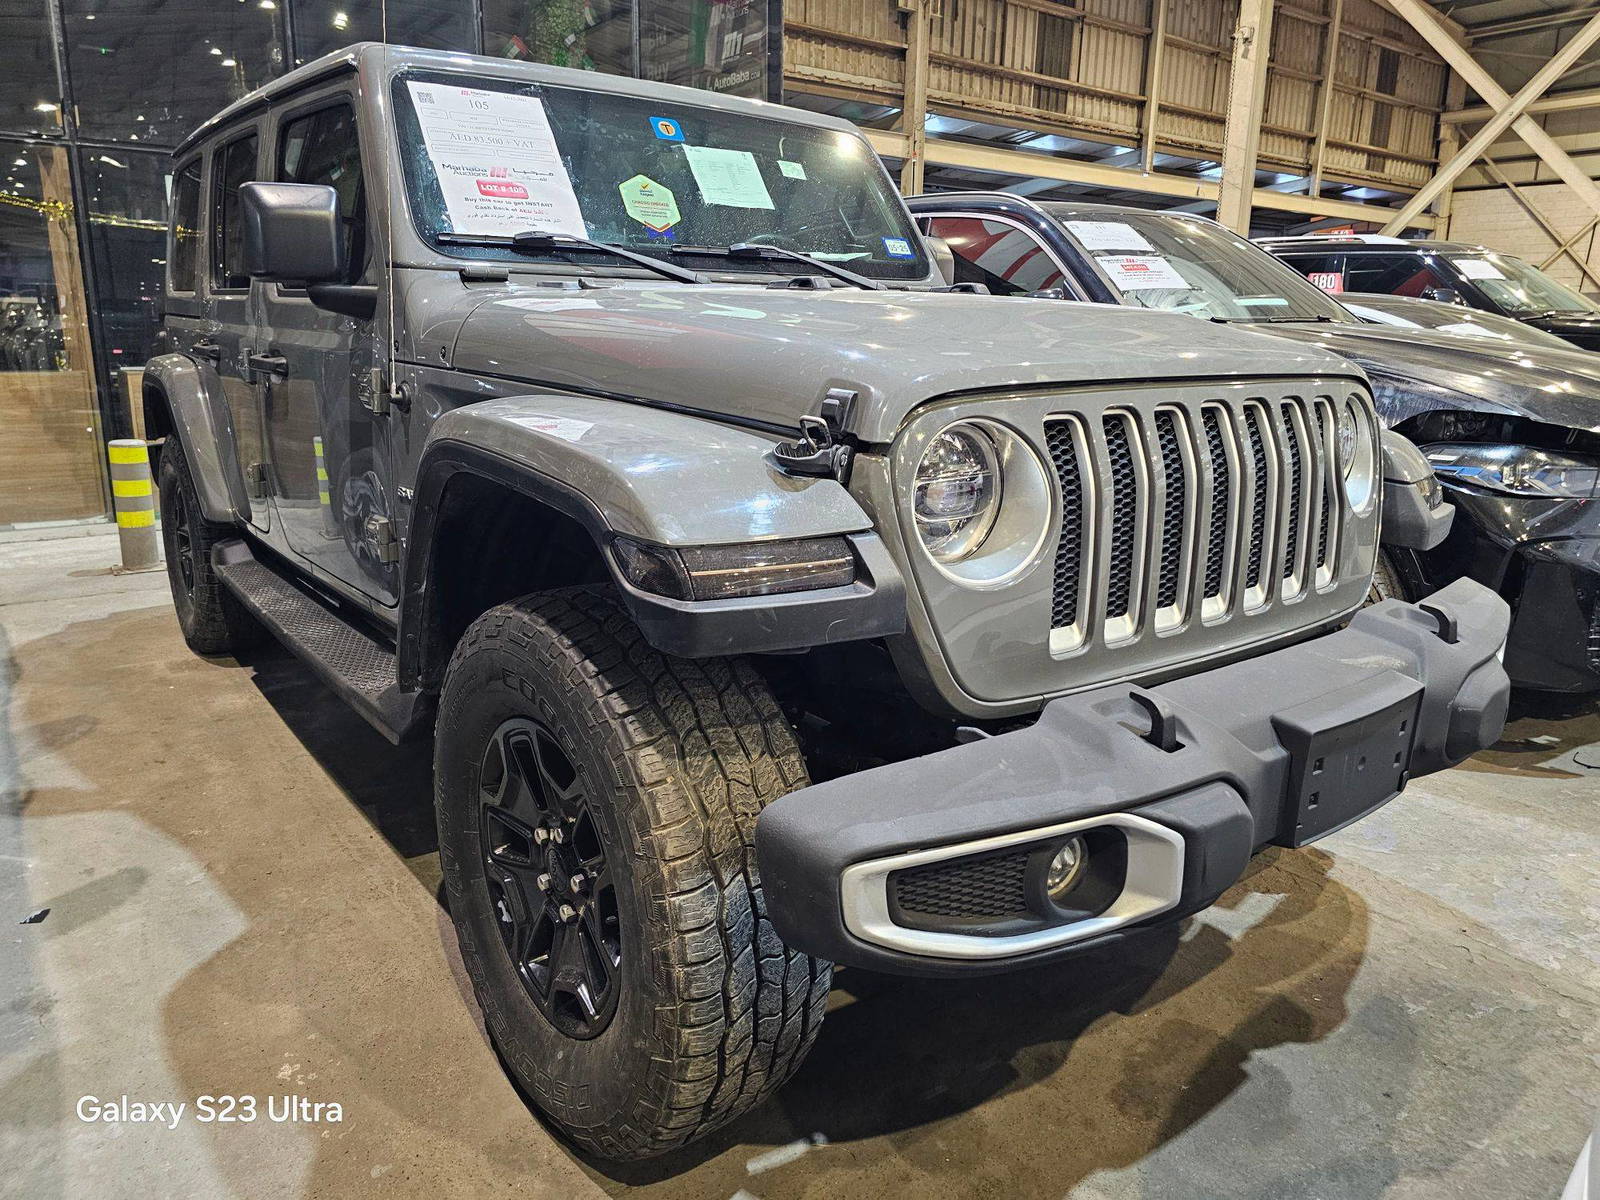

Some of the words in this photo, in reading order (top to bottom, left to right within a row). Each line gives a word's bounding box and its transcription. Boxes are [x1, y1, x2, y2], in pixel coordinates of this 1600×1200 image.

[469, 99, 489, 110] 105
[661, 123, 672, 135] T
[449, 133, 471, 142] AED
[512, 139, 535, 148] VAT
[441, 163, 488, 173] Marhaba
[480, 184, 499, 193] LOT
[1311, 275, 1335, 289] 180
[502, 667, 612, 845] COOPER
